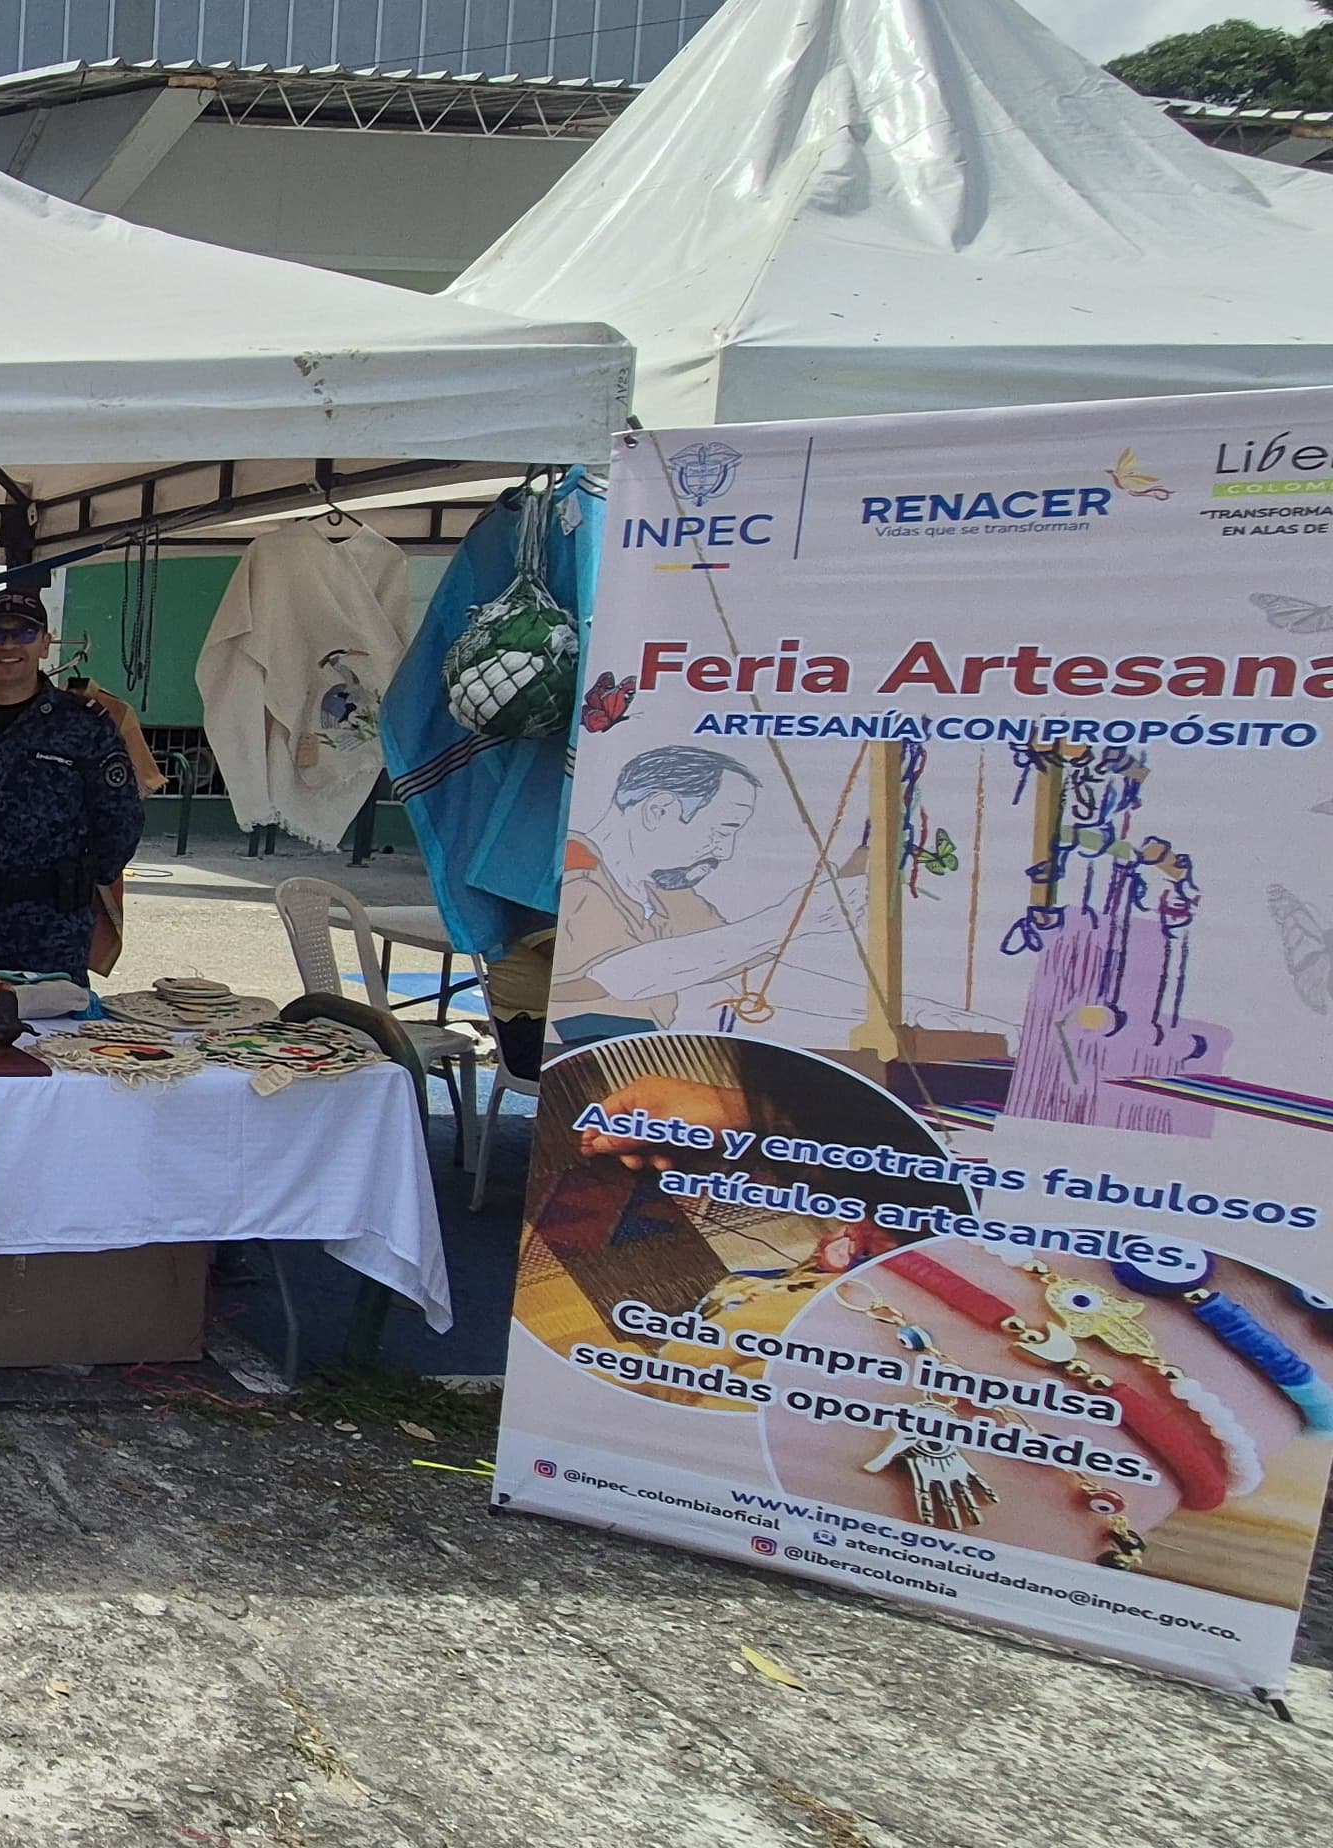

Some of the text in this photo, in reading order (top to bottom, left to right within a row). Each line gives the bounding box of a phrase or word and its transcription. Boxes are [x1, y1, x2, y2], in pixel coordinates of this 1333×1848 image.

[1215, 430, 1333, 474] Libe
[861, 487, 1112, 525] RENACER
[1226, 481, 1333, 494] COLOM
[622, 513, 774, 549] INPEC
[875, 521, 1090, 537] Vidas que se transforman
[1221, 522, 1330, 537] EN ALAS DE
[637, 638, 853, 695] Feria
[694, 708, 1318, 748] ARTESANÍA CON PROPÓSITO
[575, 1104, 1319, 1229] Asiste y encotraras fabulosos
[660, 1168, 1198, 1270] artículos artesanales.
[617, 1304, 1117, 1424] Cada compra impulsa
[574, 1343, 1154, 1482] segundas oportunidades.
[563, 1469, 782, 1531] @inpec_colombiaoficial
[730, 1489, 997, 1563] www.inpec.gov.co
[783, 1545, 959, 1599] @liberacolombia
[844, 1536, 1242, 1643] atencionalciudadano@inpec.gov.co.
